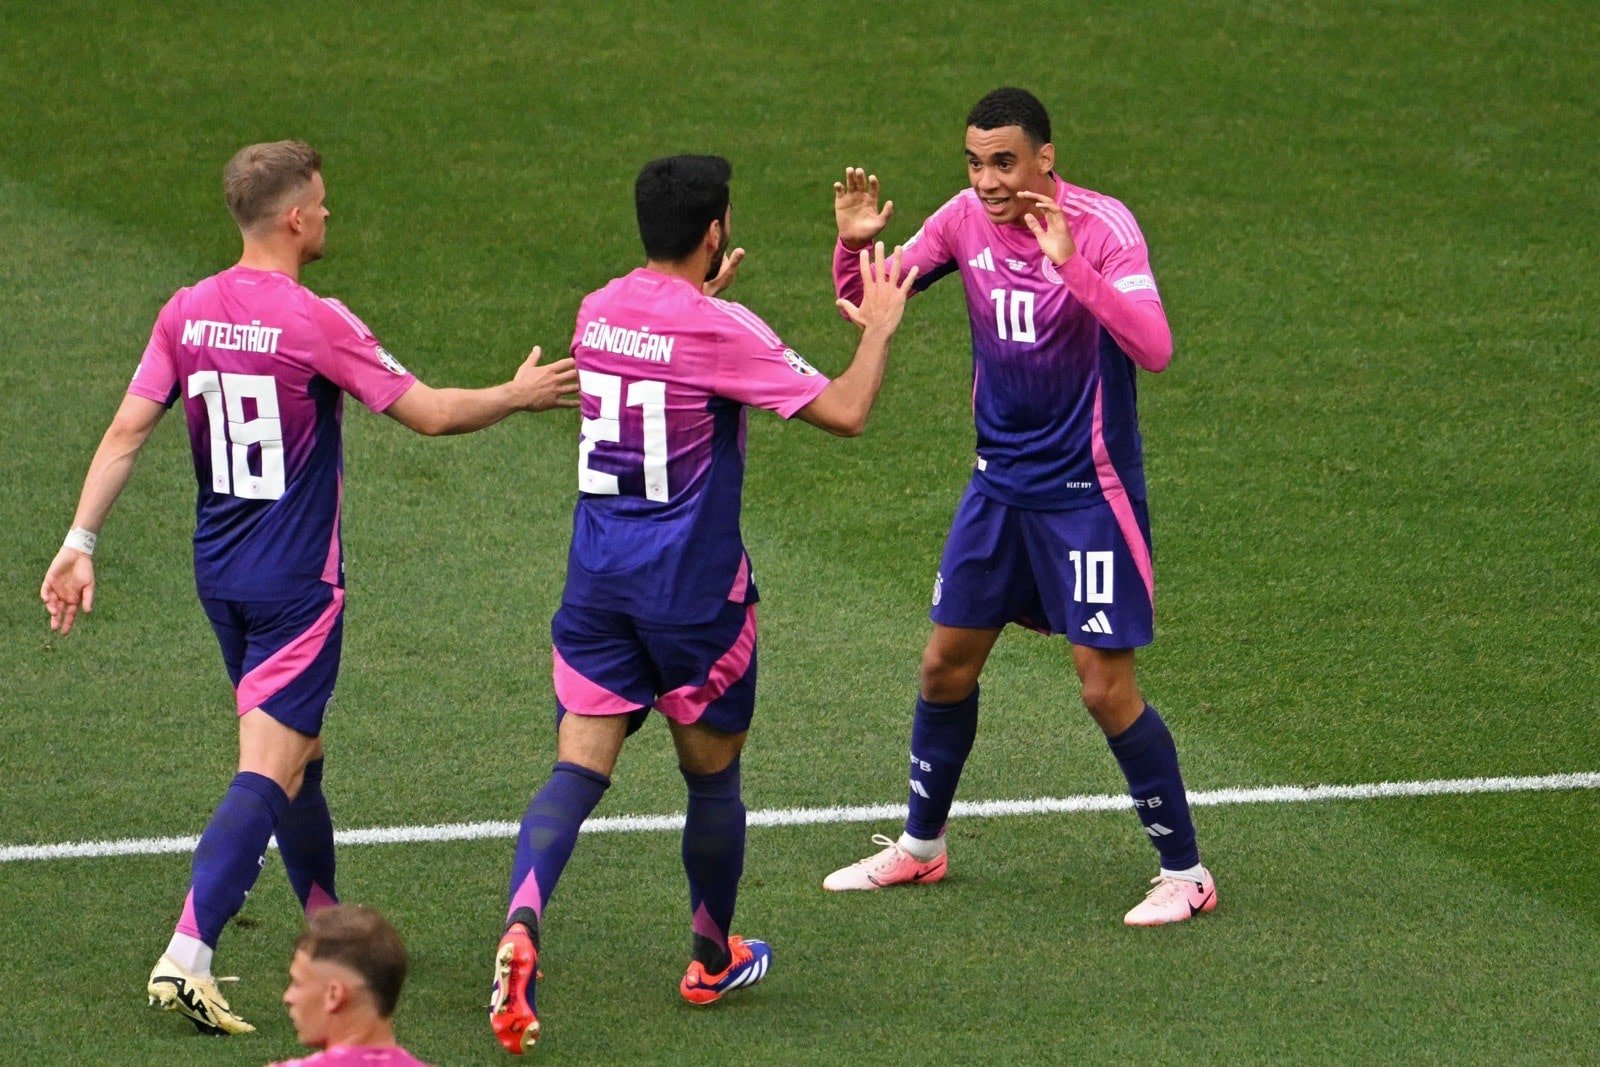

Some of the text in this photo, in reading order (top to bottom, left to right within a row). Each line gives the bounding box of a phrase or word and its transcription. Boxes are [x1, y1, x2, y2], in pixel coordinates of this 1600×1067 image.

[990, 288, 1037, 344] 10
[187, 370, 286, 500] 18
[578, 369, 669, 503] 21
[1069, 550, 1114, 604] 10
[909, 751, 932, 772] FB
